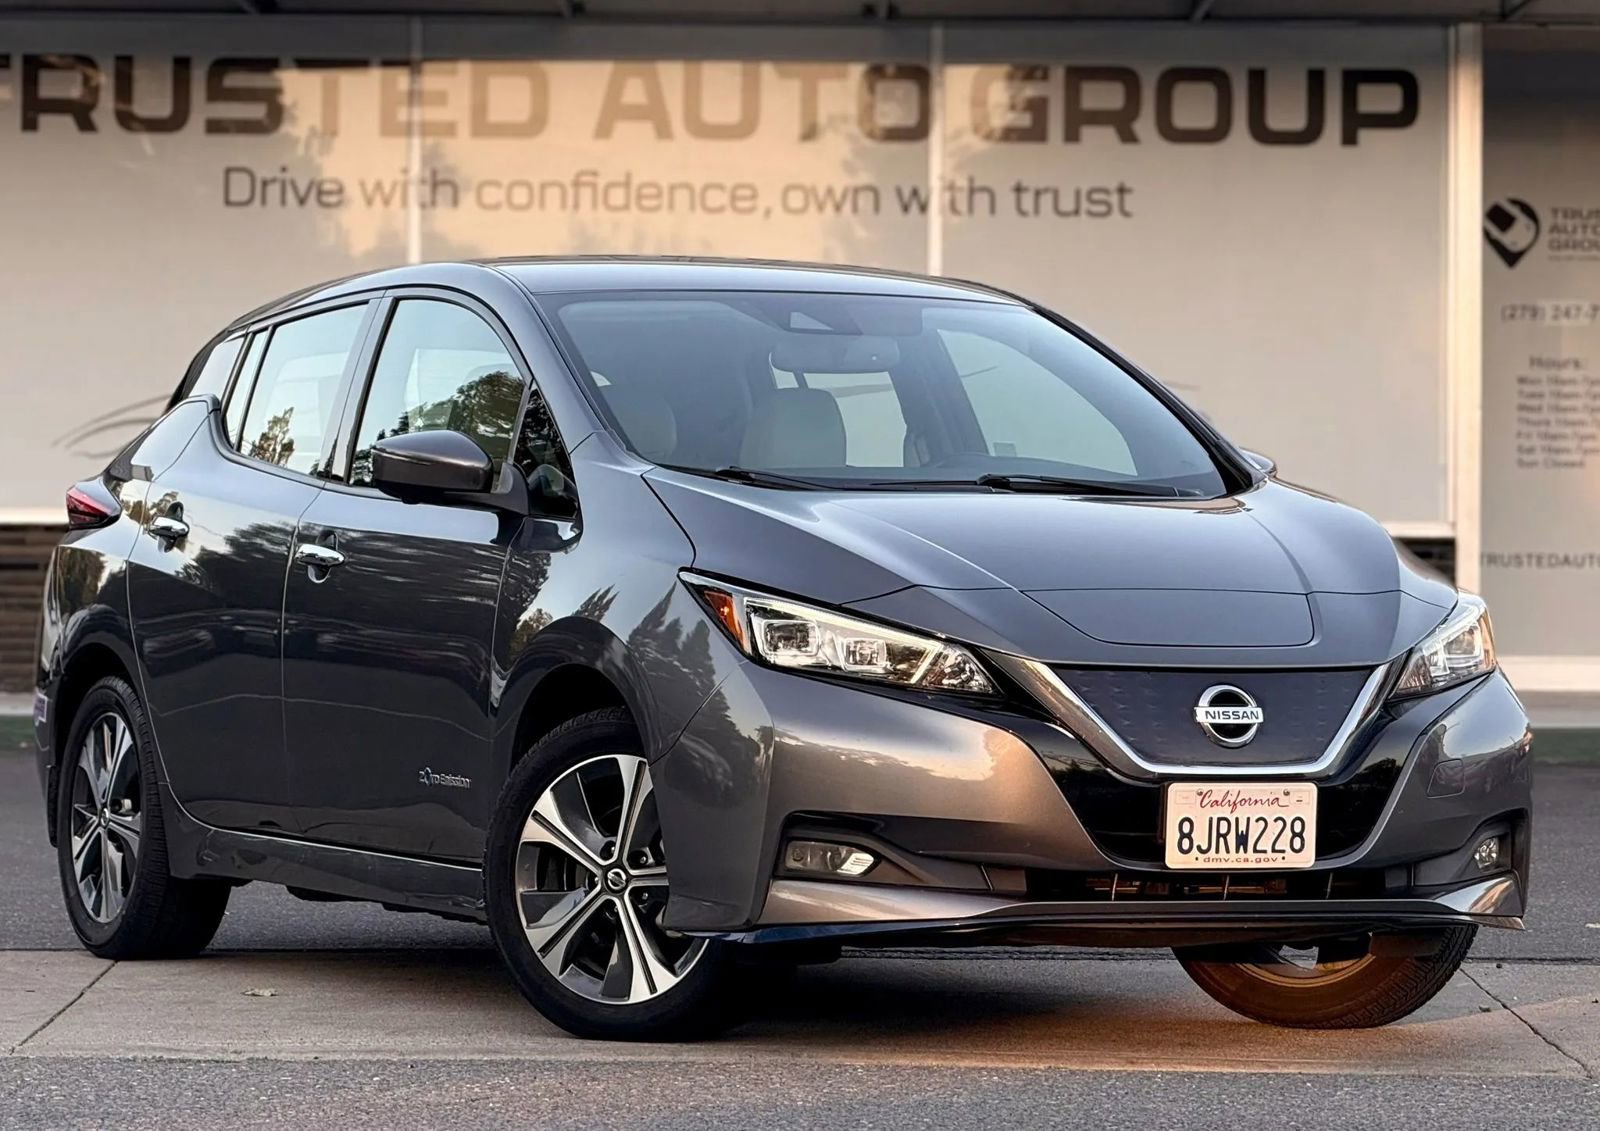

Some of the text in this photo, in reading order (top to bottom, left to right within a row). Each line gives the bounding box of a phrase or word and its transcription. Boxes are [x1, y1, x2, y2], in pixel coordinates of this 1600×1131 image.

[0, 54, 1420, 146] RUSTED AUTO GROUP
[223, 166, 344, 208] Drive
[474, 169, 772, 219] confidence,
[781, 180, 881, 214] own
[895, 174, 996, 217] wth
[1010, 180, 1134, 218] trust
[1204, 710, 1260, 721] NISSAN
[1200, 789, 1290, 814] California
[1177, 816, 1306, 855] 8JRW228
[1203, 856, 1278, 864] dmv.ca.gov
